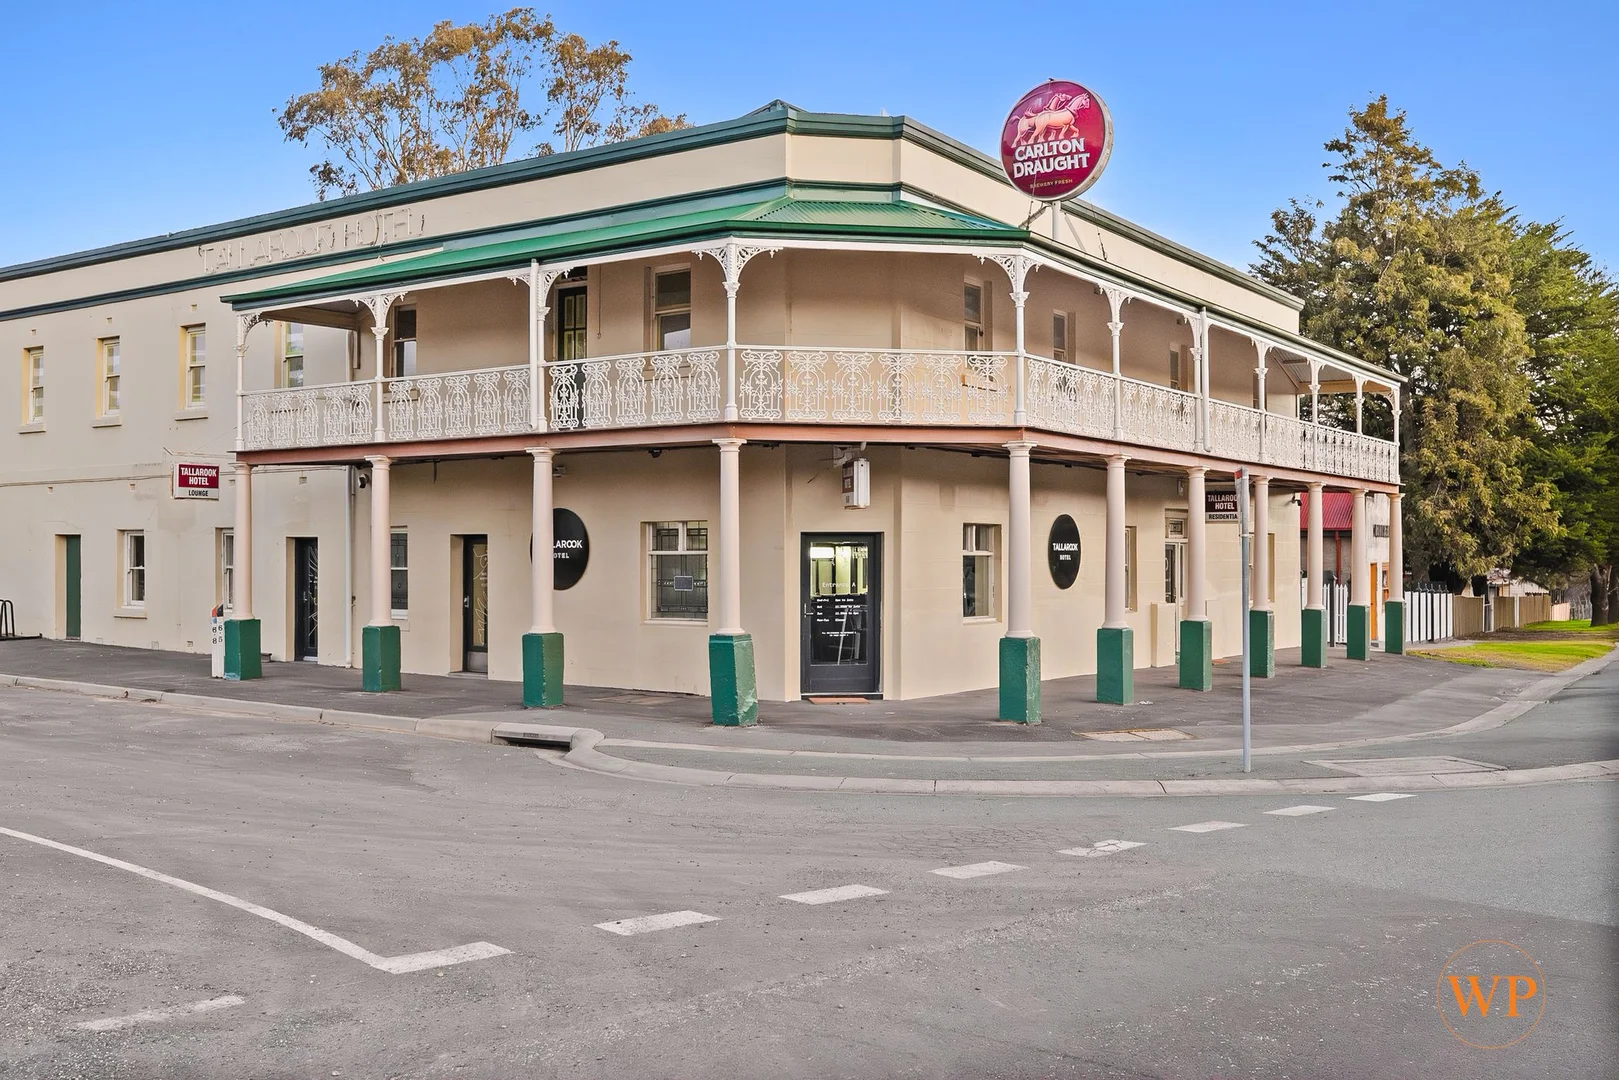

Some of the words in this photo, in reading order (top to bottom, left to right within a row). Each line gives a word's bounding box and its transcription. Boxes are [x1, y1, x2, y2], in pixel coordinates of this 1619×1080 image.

[1014, 137, 1085, 161] CARLTON
[1012, 153, 1090, 179] DRAUGHT
[180, 467, 217, 477] TALLAROOK
[188, 476, 209, 486] HOTEL
[1207, 494, 1238, 502] TALLAROO
[1052, 542, 1078, 551] TALLAROOK
